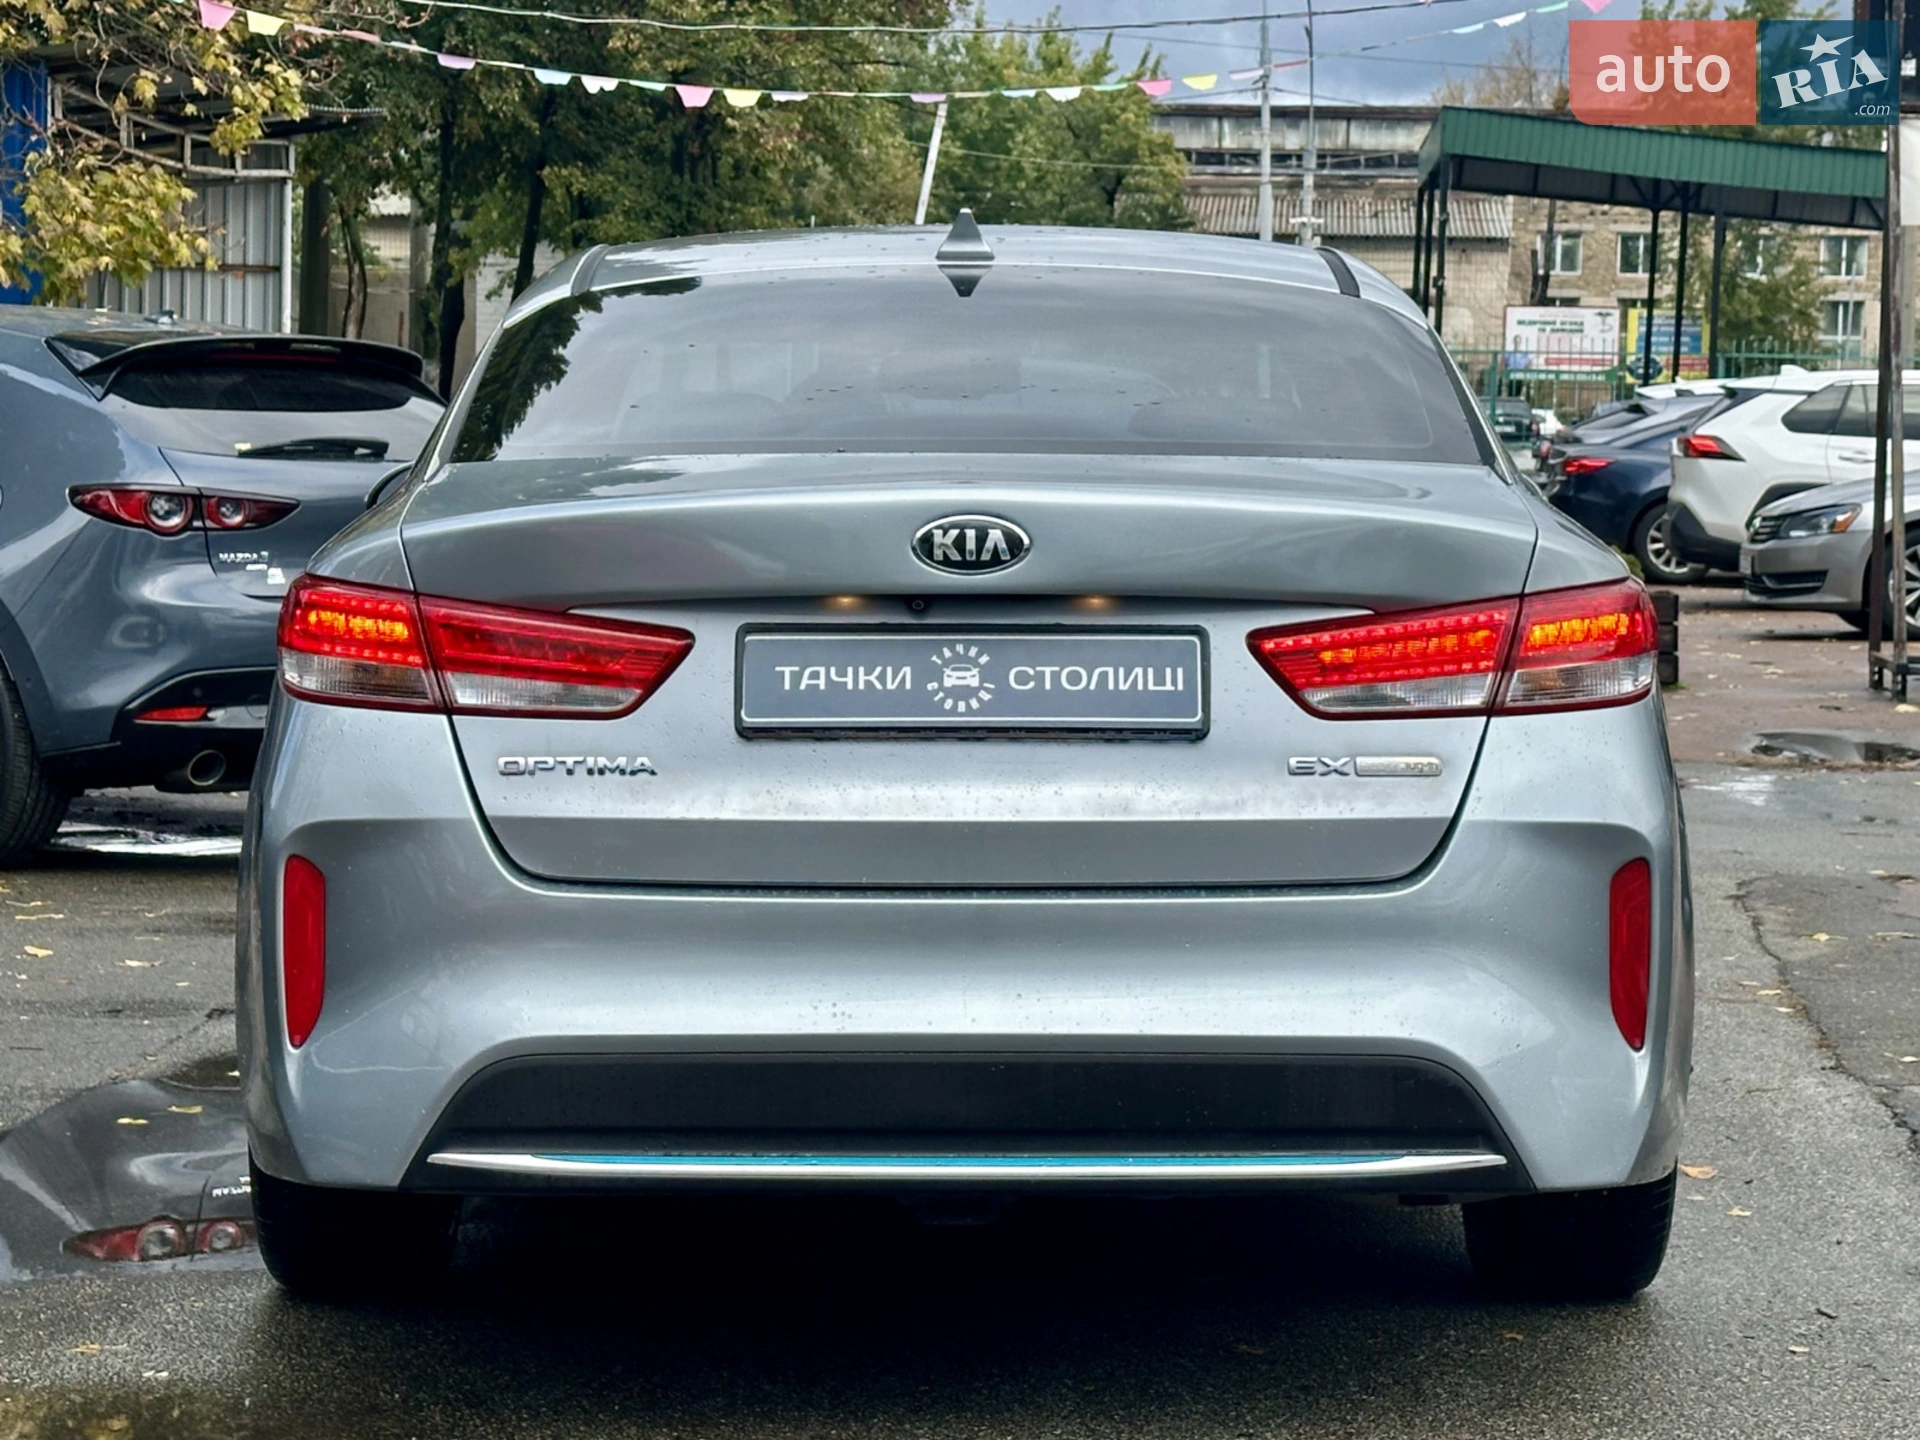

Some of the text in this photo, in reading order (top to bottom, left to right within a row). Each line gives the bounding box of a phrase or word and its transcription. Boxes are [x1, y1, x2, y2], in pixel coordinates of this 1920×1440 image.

[931, 528, 1012, 562] KIA
[775, 665, 1185, 692] ТАЧКИ СТОЛИЦІ
[497, 756, 658, 777] OPTIMA
[1287, 756, 1351, 777] EX
